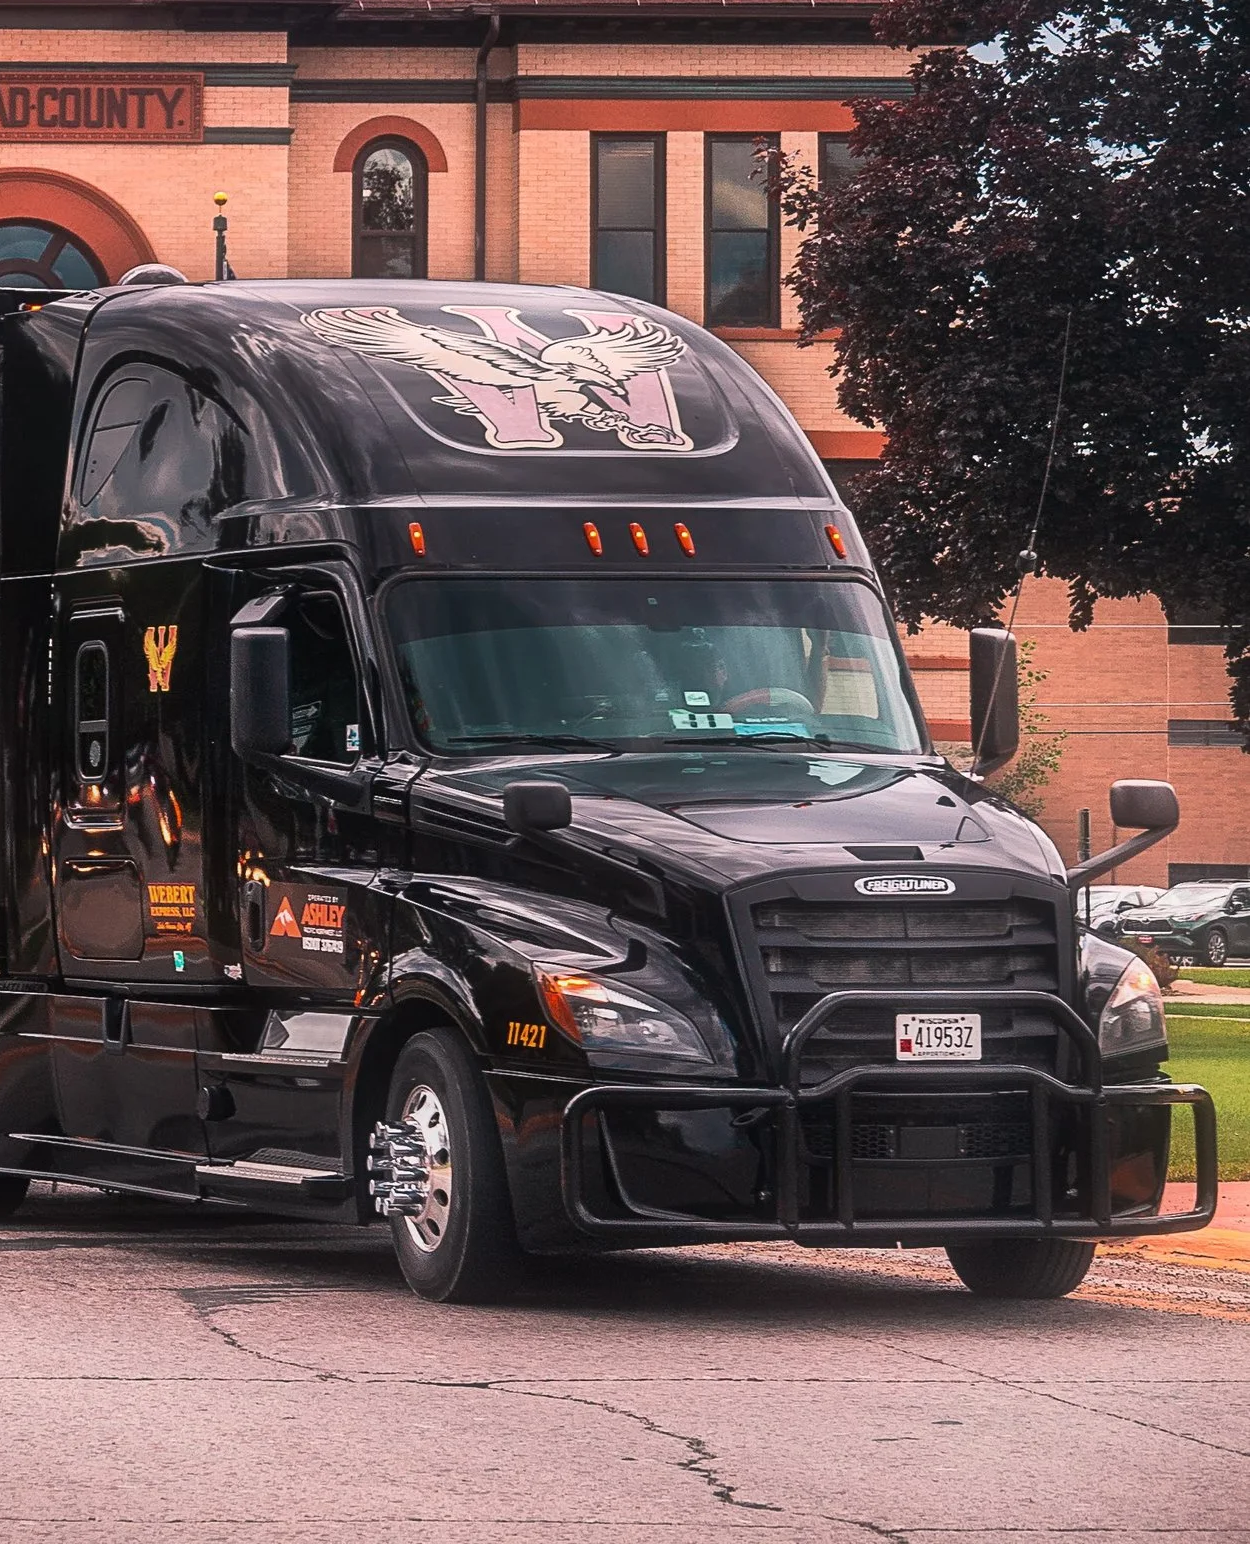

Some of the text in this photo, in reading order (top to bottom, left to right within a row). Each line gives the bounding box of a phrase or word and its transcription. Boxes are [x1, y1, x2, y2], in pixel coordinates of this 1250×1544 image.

[148, 885, 196, 904] WEBERT
[866, 879, 946, 892] FREIGHTLINER
[301, 902, 346, 928] ASHLEY
[507, 1021, 546, 1048] 11421
[915, 1026, 973, 1048] 41953Z
